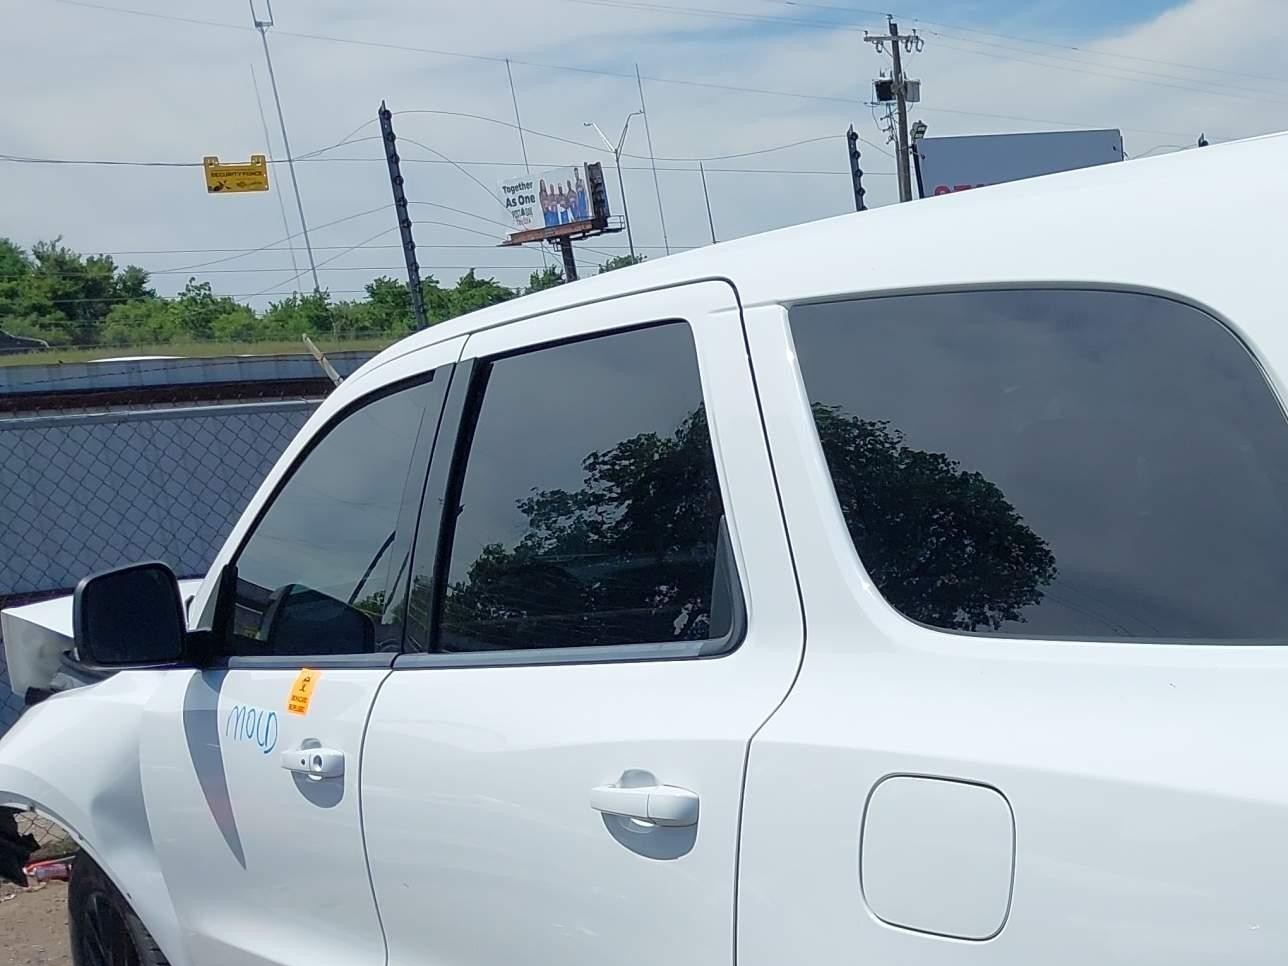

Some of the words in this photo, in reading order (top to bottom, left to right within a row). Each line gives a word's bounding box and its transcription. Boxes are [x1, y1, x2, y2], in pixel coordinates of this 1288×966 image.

[502, 181, 533, 194] Together
[506, 198, 517, 208] As
[518, 194, 535, 205] One
